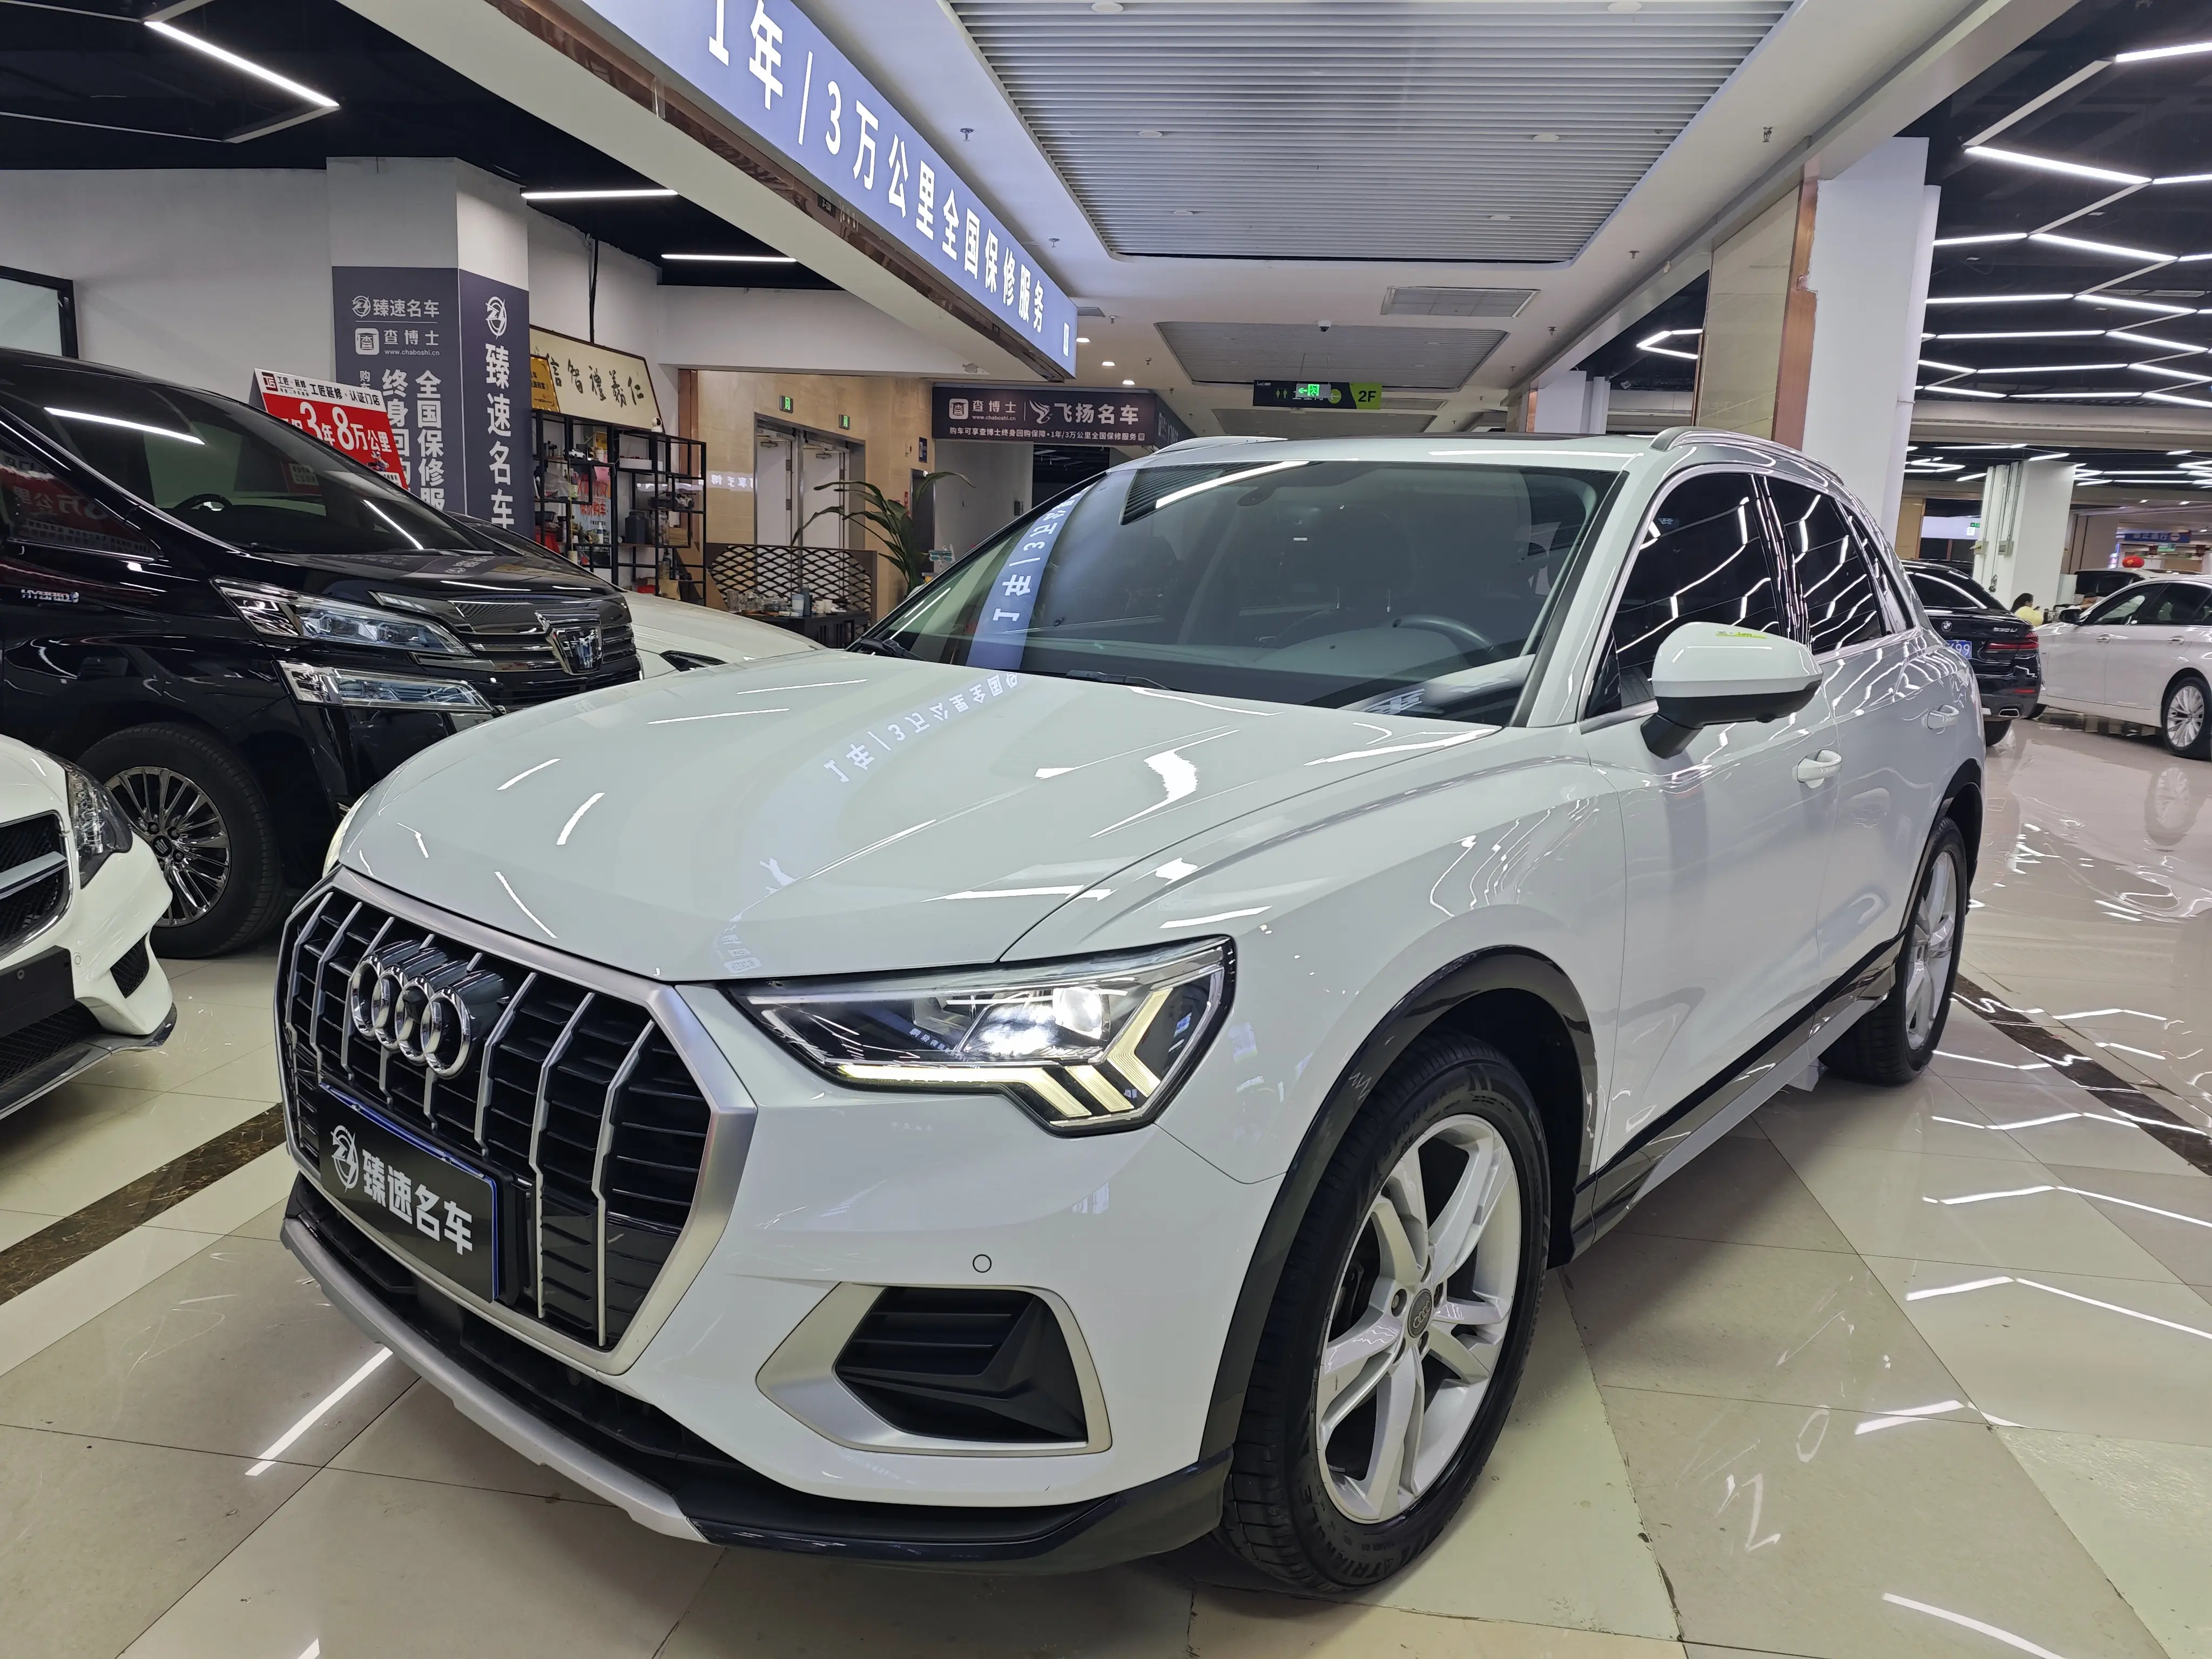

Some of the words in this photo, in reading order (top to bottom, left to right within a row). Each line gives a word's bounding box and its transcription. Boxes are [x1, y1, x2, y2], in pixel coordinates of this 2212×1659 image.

[373, 299, 440, 318] 臻速名车
[384, 329, 439, 346] 查博士
[1358, 390, 1377, 402] 2F
[972, 400, 1016, 413] 查博士
[1054, 402, 1139, 425] 飞扬名车
[281, 401, 392, 453] 3年8万公里
[485, 343, 514, 529] 臻速名车
[1950, 643, 1971, 656] 99
[362, 1149, 473, 1255] 臻速名车
